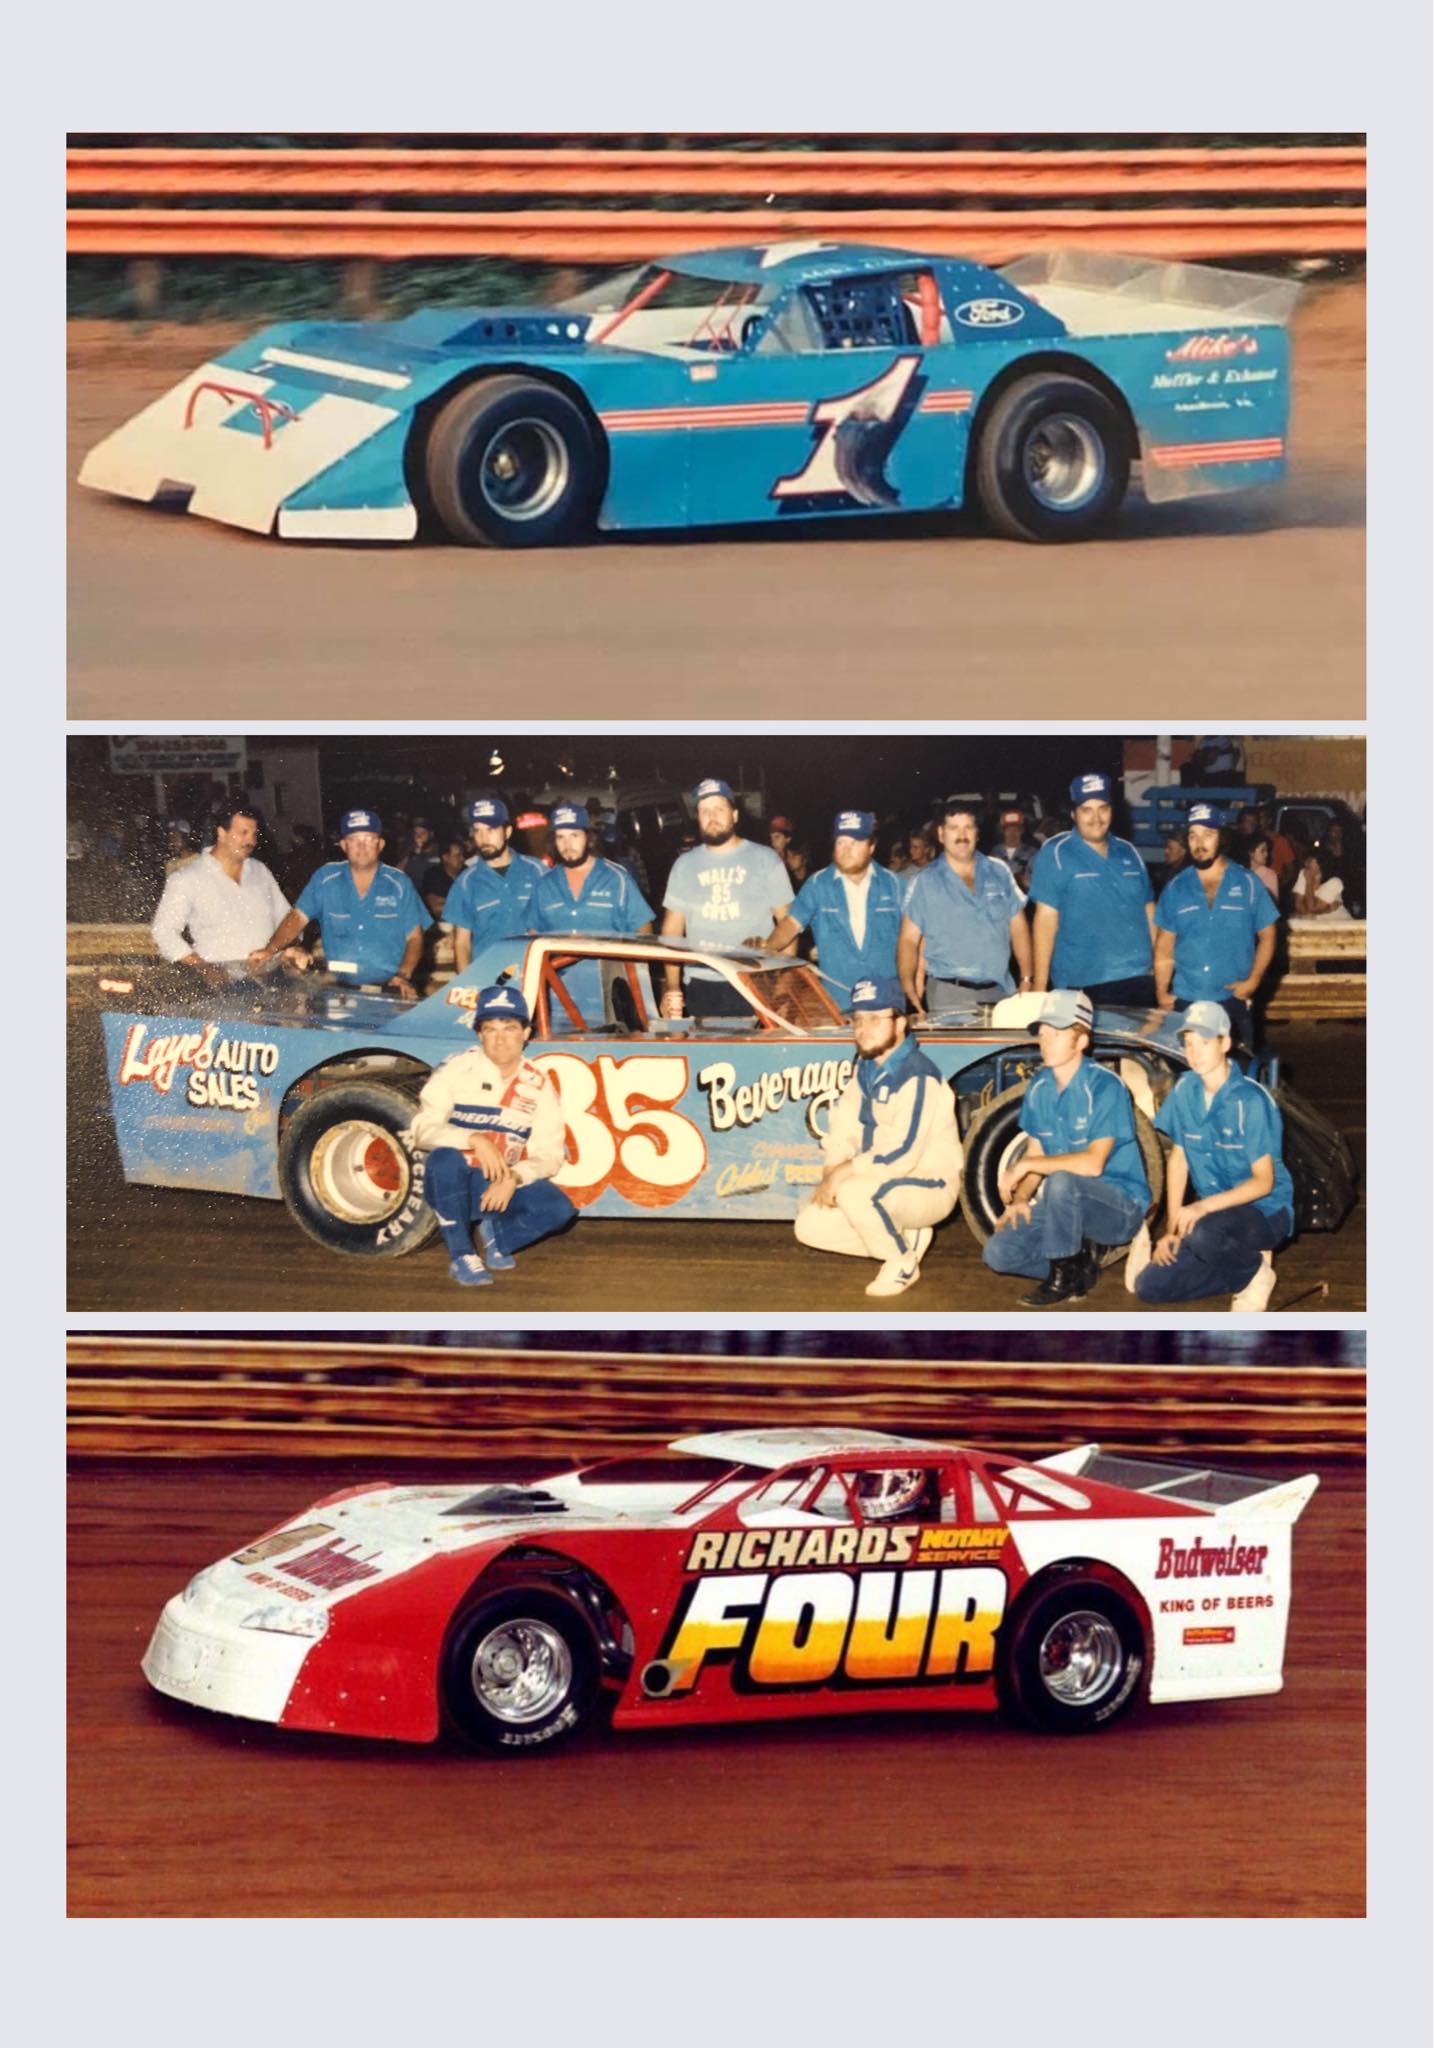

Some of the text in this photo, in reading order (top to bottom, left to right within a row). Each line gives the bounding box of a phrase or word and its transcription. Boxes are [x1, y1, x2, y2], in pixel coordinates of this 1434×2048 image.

[968, 302, 1012, 322] Ford
[1165, 334, 1258, 361] Mike's
[1206, 371, 1219, 384] &
[769, 354, 929, 512] 1
[697, 865, 747, 887] WALL'S
[711, 884, 732, 904] 85
[702, 903, 740, 921] CREW
[213, 1038, 280, 1077] AUTO
[186, 1070, 262, 1113] SALES
[532, 1052, 707, 1208] 85
[684, 1525, 1010, 1572] RICHARDS NOTARY
[916, 1549, 1001, 1563] SERVICE
[1155, 1534, 1268, 1579] Budweiser
[1159, 1594, 1275, 1614] KING OF BEERS
[656, 1566, 1009, 1694] FOUR
